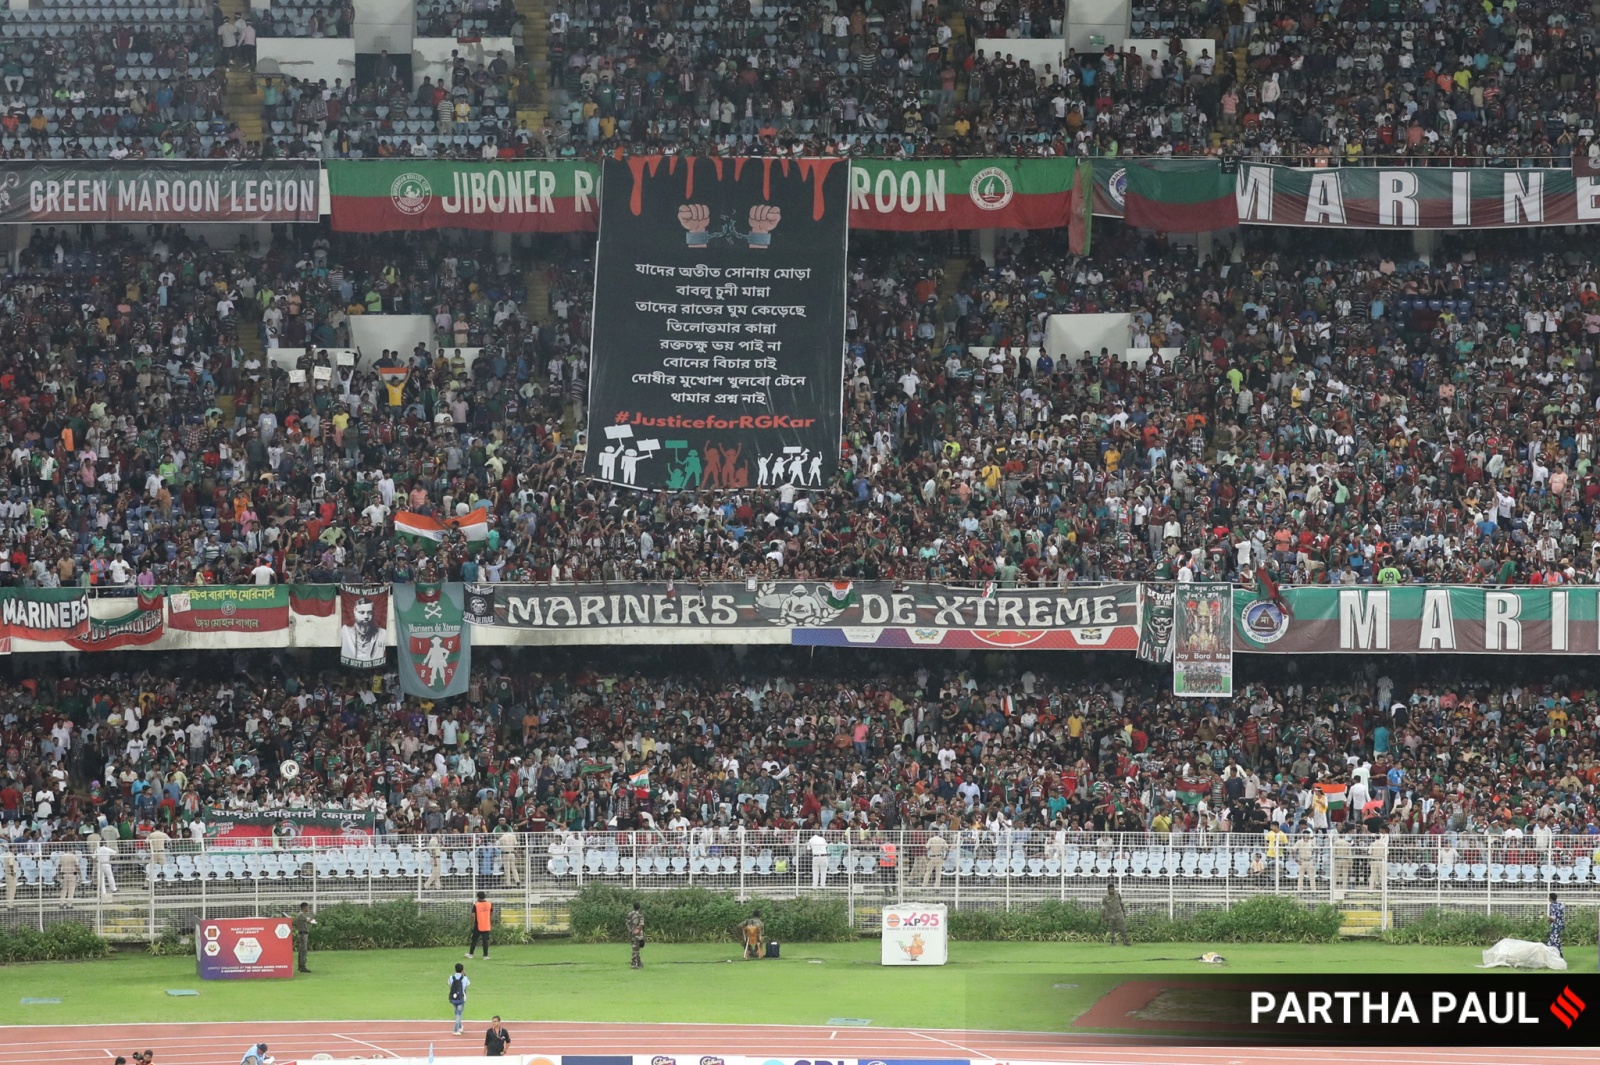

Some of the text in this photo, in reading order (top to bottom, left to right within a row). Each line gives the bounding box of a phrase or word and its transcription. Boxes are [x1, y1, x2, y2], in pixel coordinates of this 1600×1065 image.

[30, 179, 314, 212] GREEN MAROON LEGION
[441, 169, 556, 214] JIBONER
[575, 169, 600, 214] R
[635, 263, 811, 280] যাদের অতীত সোনায় মোড়া
[675, 283, 771, 300] বাবলু চুনী মান্না
[635, 301, 806, 318] তাদের রাতের ঘুম কেড়েছে
[666, 318, 777, 334] তিলোত্তমার কান্না
[659, 338, 782, 353] রক্তচক্ষু ভয় পাই না
[663, 355, 777, 370] বোনের বিচার চাই
[632, 371, 806, 389] দোষীর মুখোশ খুলবো টেনে
[670, 391, 766, 404] থামার প্রশ্ন নাই
[615, 411, 815, 429] #JusticeforRGKar
[1385, 572, 1394, 581] 99
[239, 587, 275, 601] মেরিনার্স
[345, 585, 361, 595] MAN
[361, 587, 379, 596] WILL
[3, 594, 88, 629] MARINERS
[508, 594, 738, 626] MARINERS
[861, 592, 1118, 627] DE XTREME
[195, 616, 258, 630] জয় মোহন বাগান
[408, 623, 433, 633] Mariners
[442, 622, 461, 631] Xtreme
[1340, 589, 1600, 651] MARI
[447, 640, 453, 649] 8
[420, 668, 453, 678] 8 9
[263, 808, 316, 819] মেরিনার্স
[322, 812, 365, 820] ফোরাম
[902, 912, 940, 927] XP95
